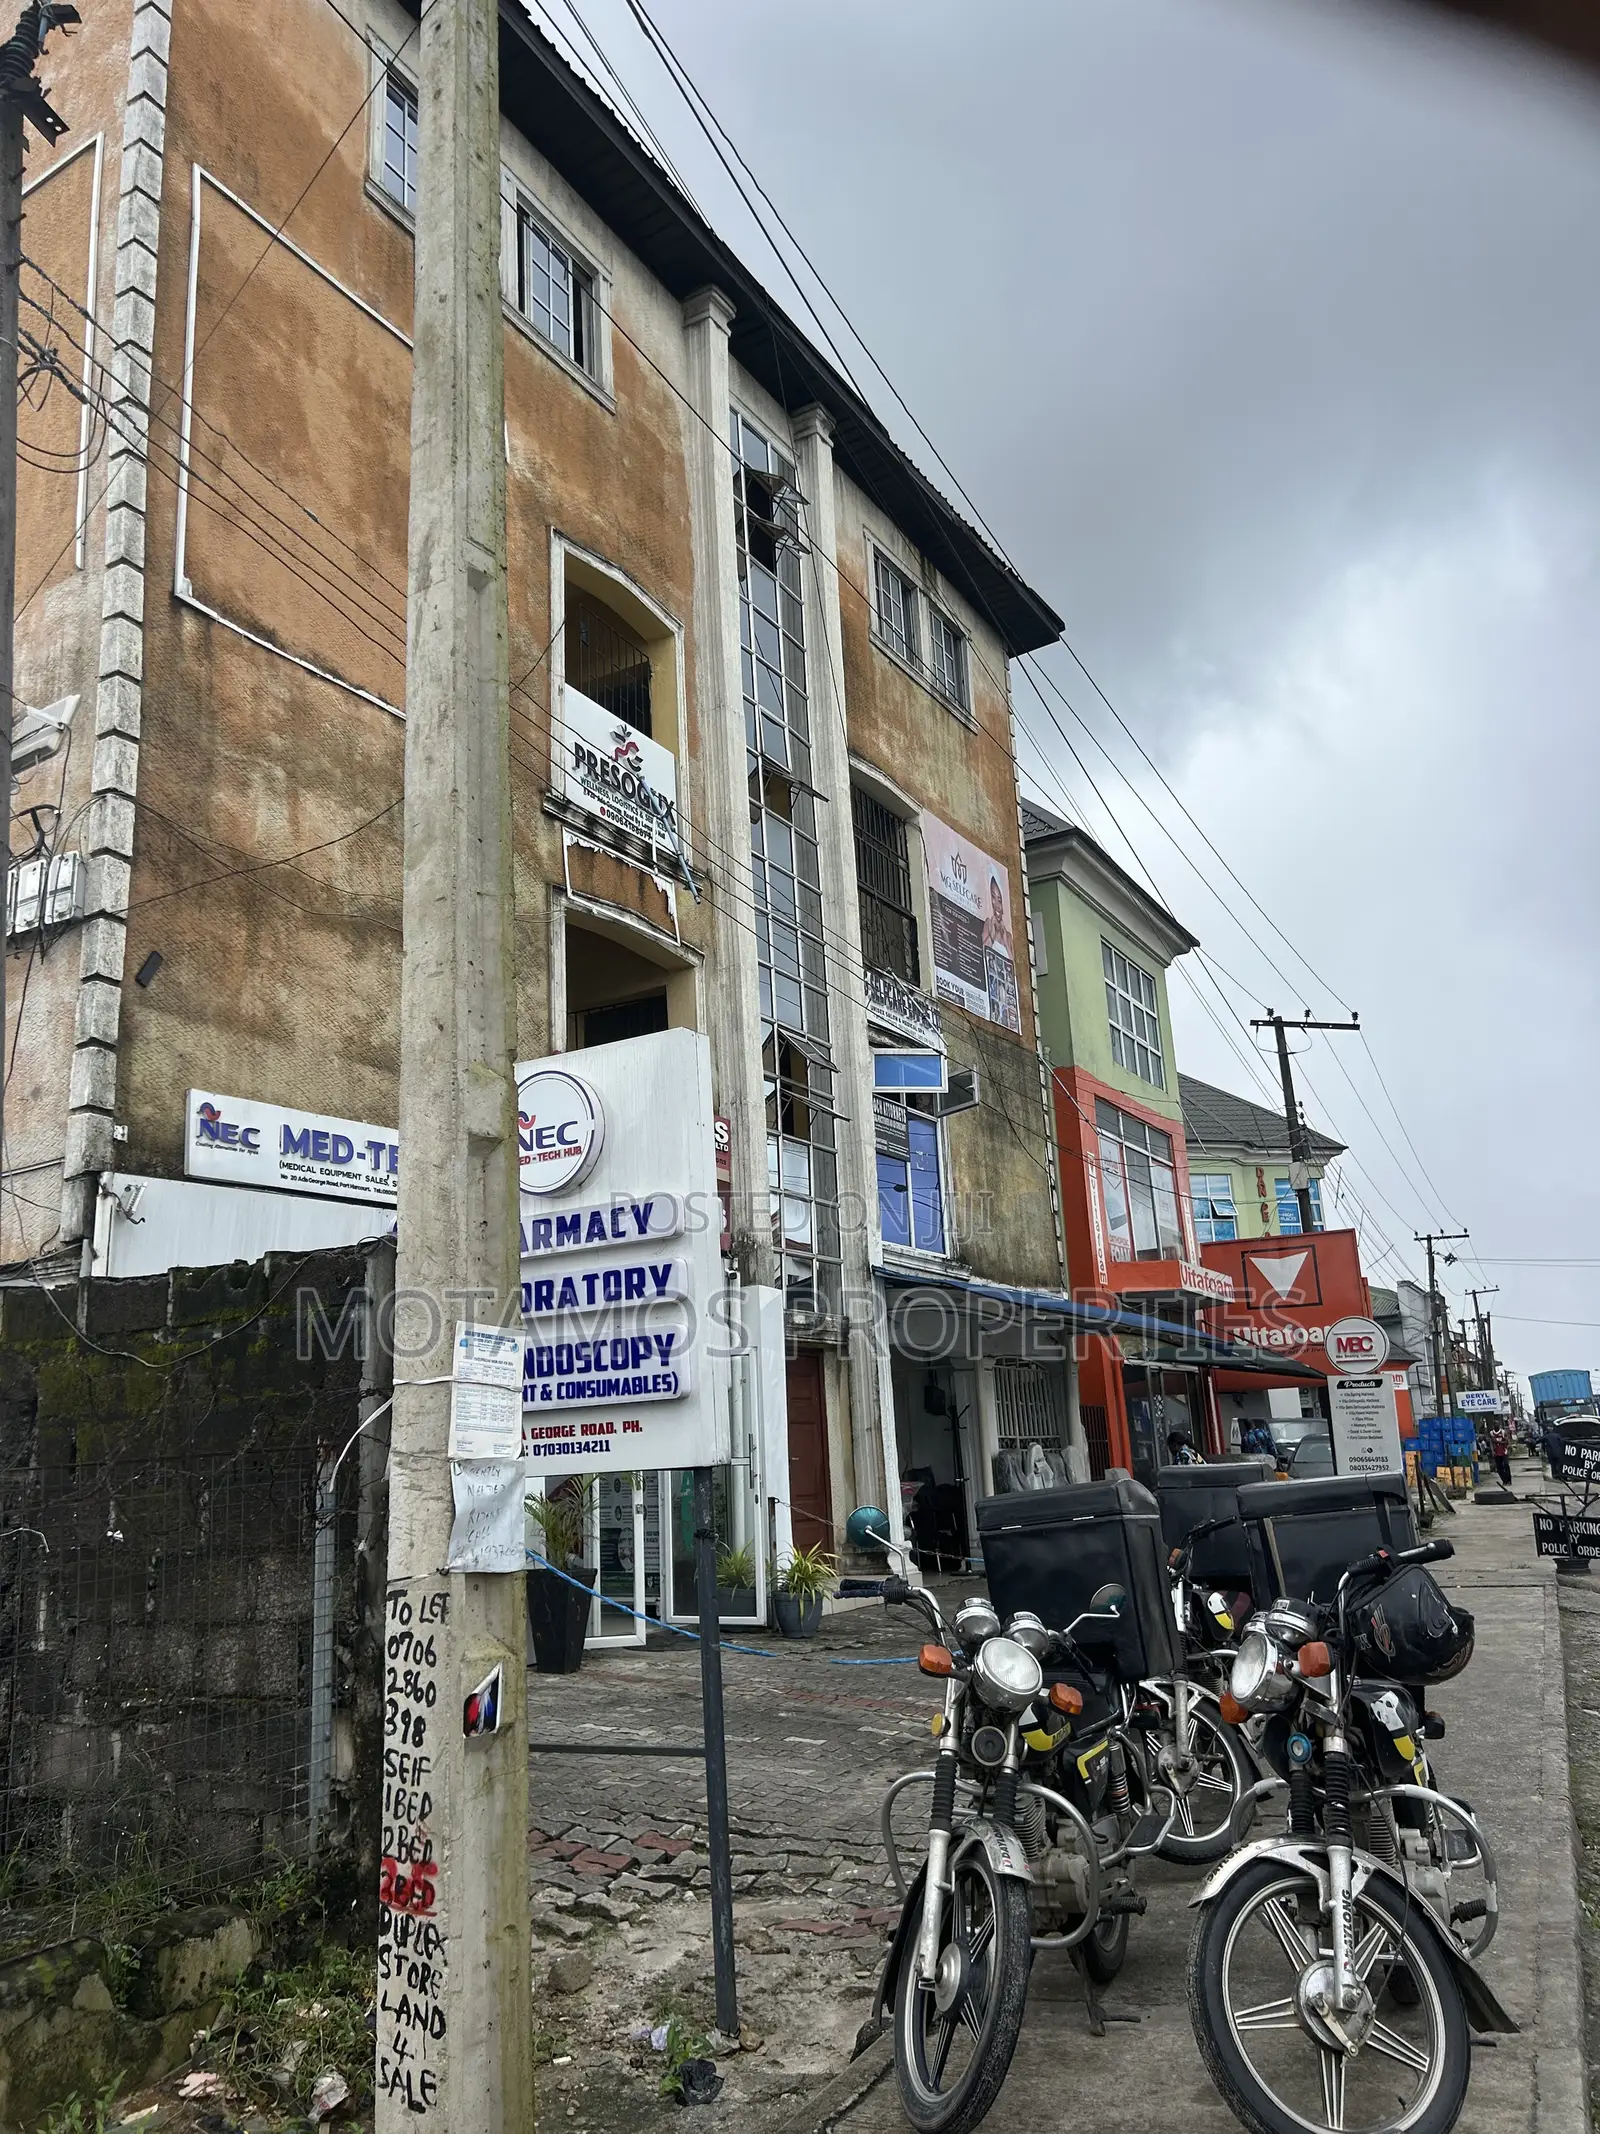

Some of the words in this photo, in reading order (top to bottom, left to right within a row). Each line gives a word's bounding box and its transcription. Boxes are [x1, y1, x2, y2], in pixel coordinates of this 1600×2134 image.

[197, 1117, 260, 1149] NEC
[519, 1121, 578, 1151] NEC
[563, 1145, 582, 1158] HUB
[716, 1143, 729, 1152] LTD
[279, 1160, 316, 1174] (MEDICAL
[320, 1167, 362, 1180] EQUIPMENT
[1336, 1335, 1373, 1353] MBC
[540, 1383, 553, 1401] &
[556, 1371, 679, 1400] CONSUMABLES)
[1477, 1398, 1497, 1406] CARE
[531, 1425, 576, 1440] GEORGE
[533, 1440, 611, 1457] 07030134211
[1564, 1444, 1577, 1457] NO
[1562, 1464, 1588, 1479] POLICE
[1584, 1459, 1597, 1470] BY
[1539, 1518, 1553, 1531] NO
[1542, 1542, 1568, 1554] POLIC
[387, 1589, 413, 1626] TO
[419, 1591, 451, 1625] LET
[387, 1631, 437, 1668] 0706
[387, 1667, 437, 1708] 2860
[384, 1698, 428, 1748] 398
[379, 1943, 443, 2000] STORE
[380, 1989, 446, 2040] LAND
[393, 2030, 414, 2065] 4
[378, 2057, 438, 2114] SALE
